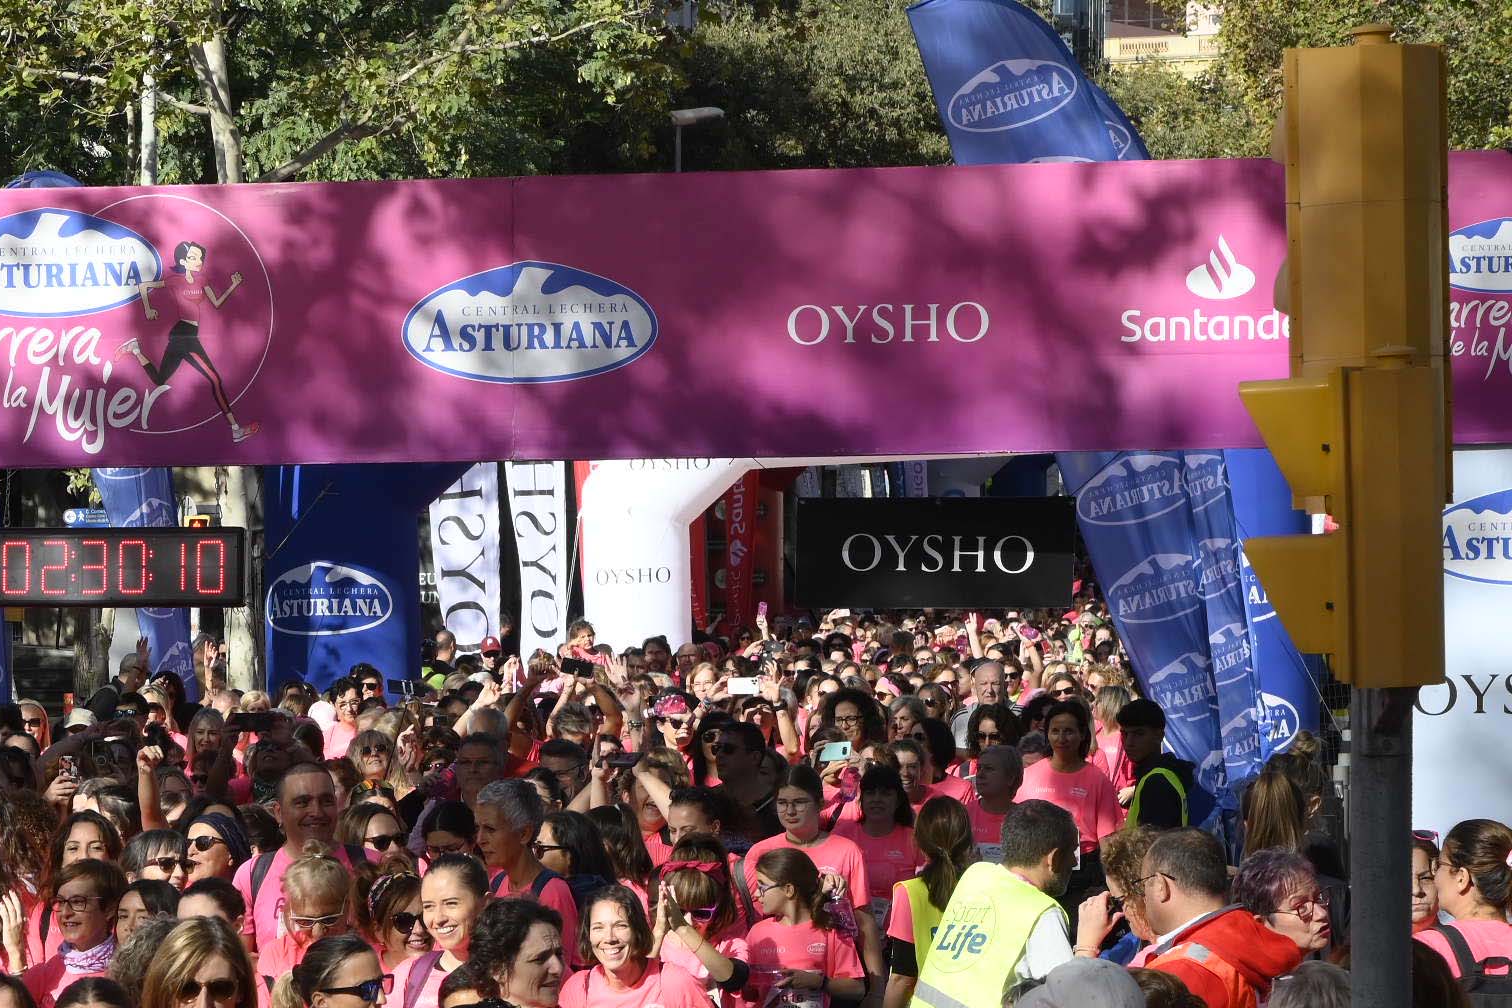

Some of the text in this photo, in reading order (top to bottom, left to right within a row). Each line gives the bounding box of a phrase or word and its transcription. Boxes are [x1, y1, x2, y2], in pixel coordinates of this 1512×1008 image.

[462, 302, 630, 317] CENTRAL LECHERA
[787, 302, 989, 345] OYSHO
[423, 308, 638, 353] ASTURIANA
[2, 368, 28, 409] la
[22, 359, 172, 455] Mujer
[841, 532, 1036, 575] OYSHO
[1443, 525, 1512, 561] ASTU
[2, 540, 224, 595] 02:30:10
[596, 566, 671, 585] OYSHO
[271, 591, 384, 618] ASTURIANA
[935, 924, 988, 960] Life
